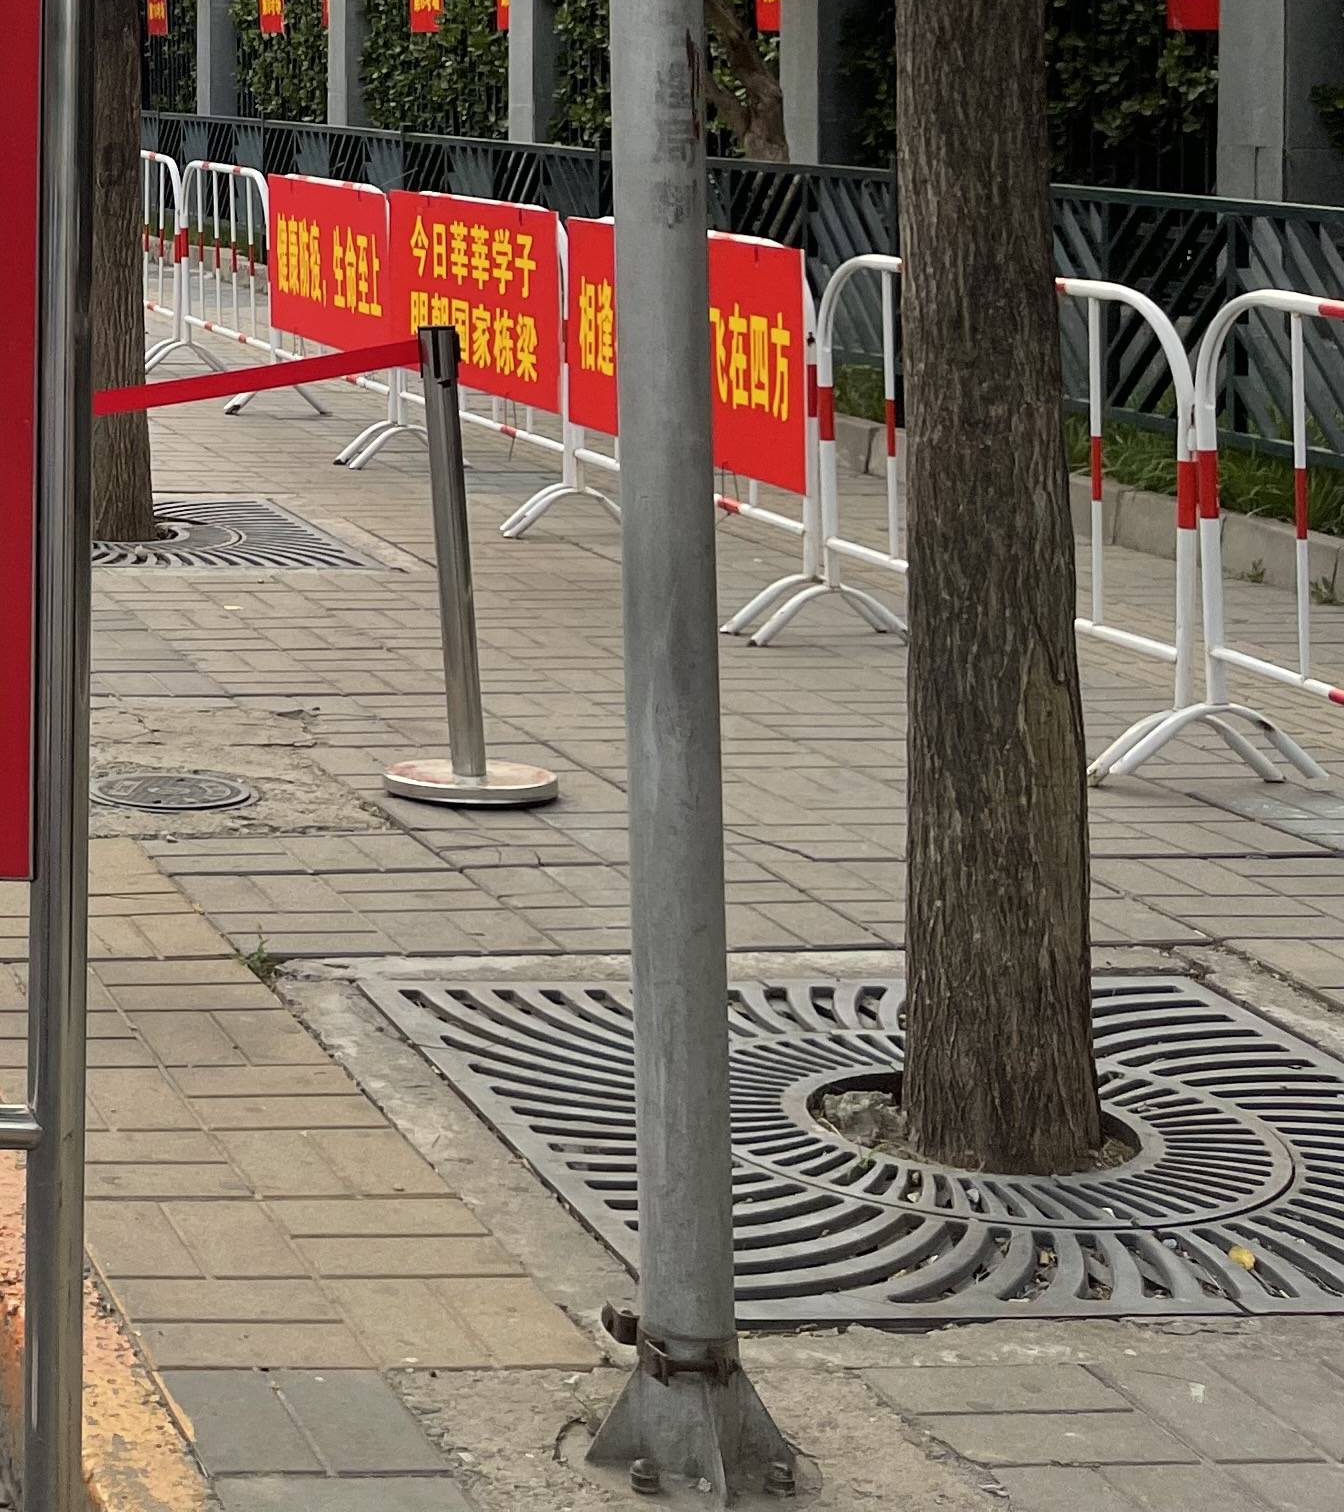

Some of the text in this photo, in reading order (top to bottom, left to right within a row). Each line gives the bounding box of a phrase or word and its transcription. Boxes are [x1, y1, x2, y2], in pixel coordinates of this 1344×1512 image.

[410, 215, 537, 298] 今日莘莘学子
